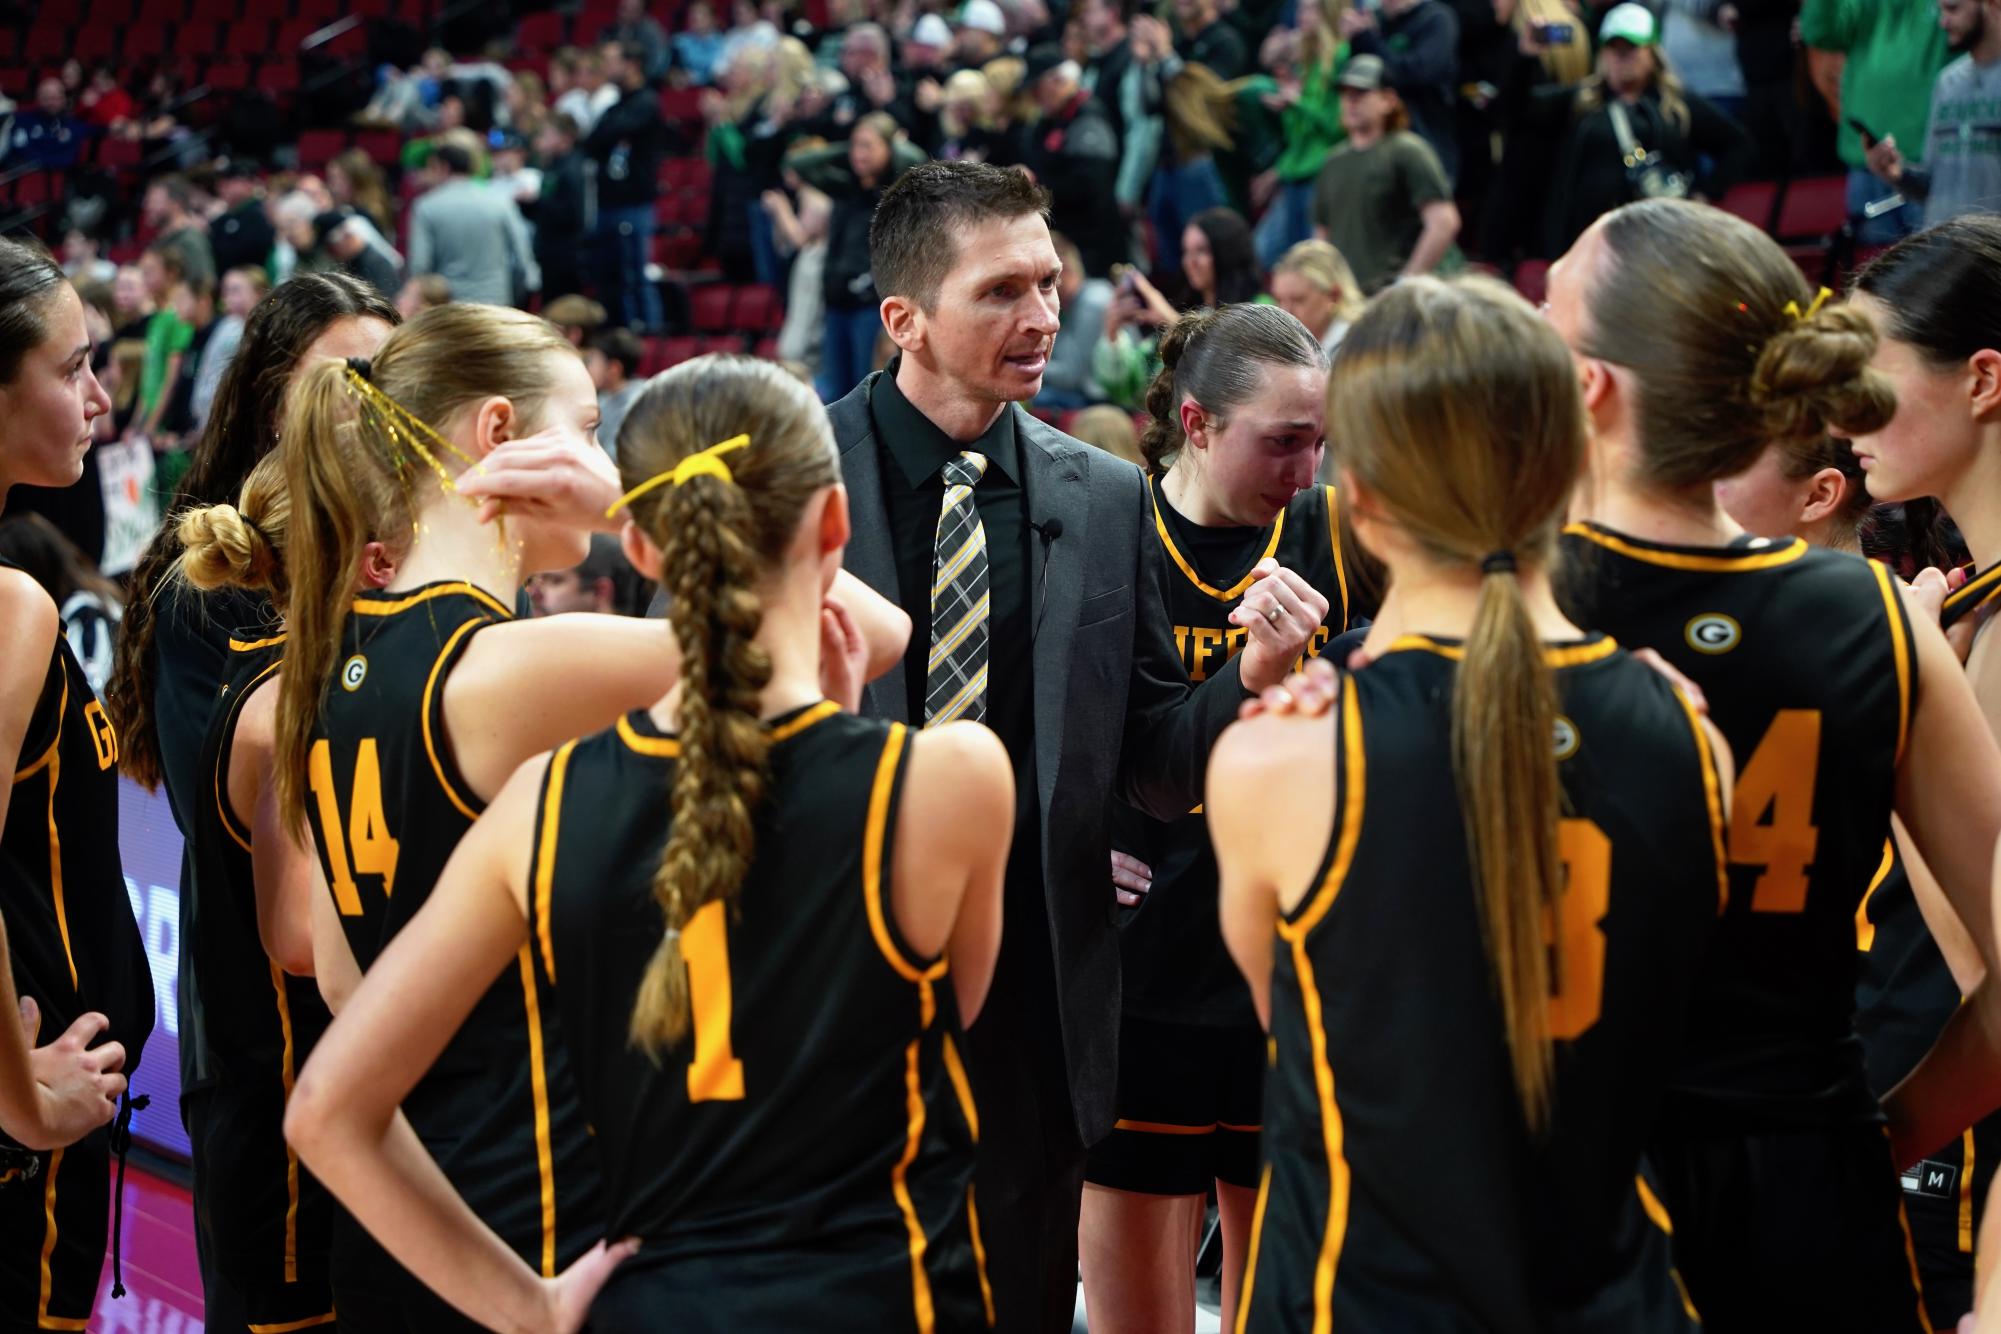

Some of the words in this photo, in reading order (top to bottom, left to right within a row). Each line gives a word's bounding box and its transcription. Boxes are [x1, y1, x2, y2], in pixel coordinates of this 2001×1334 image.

[1696, 623, 1730, 645] G
[347, 663, 363, 683] G
[308, 737, 400, 916] 14
[680, 898, 746, 1104] 1
[1927, 1171, 1945, 1188] M
